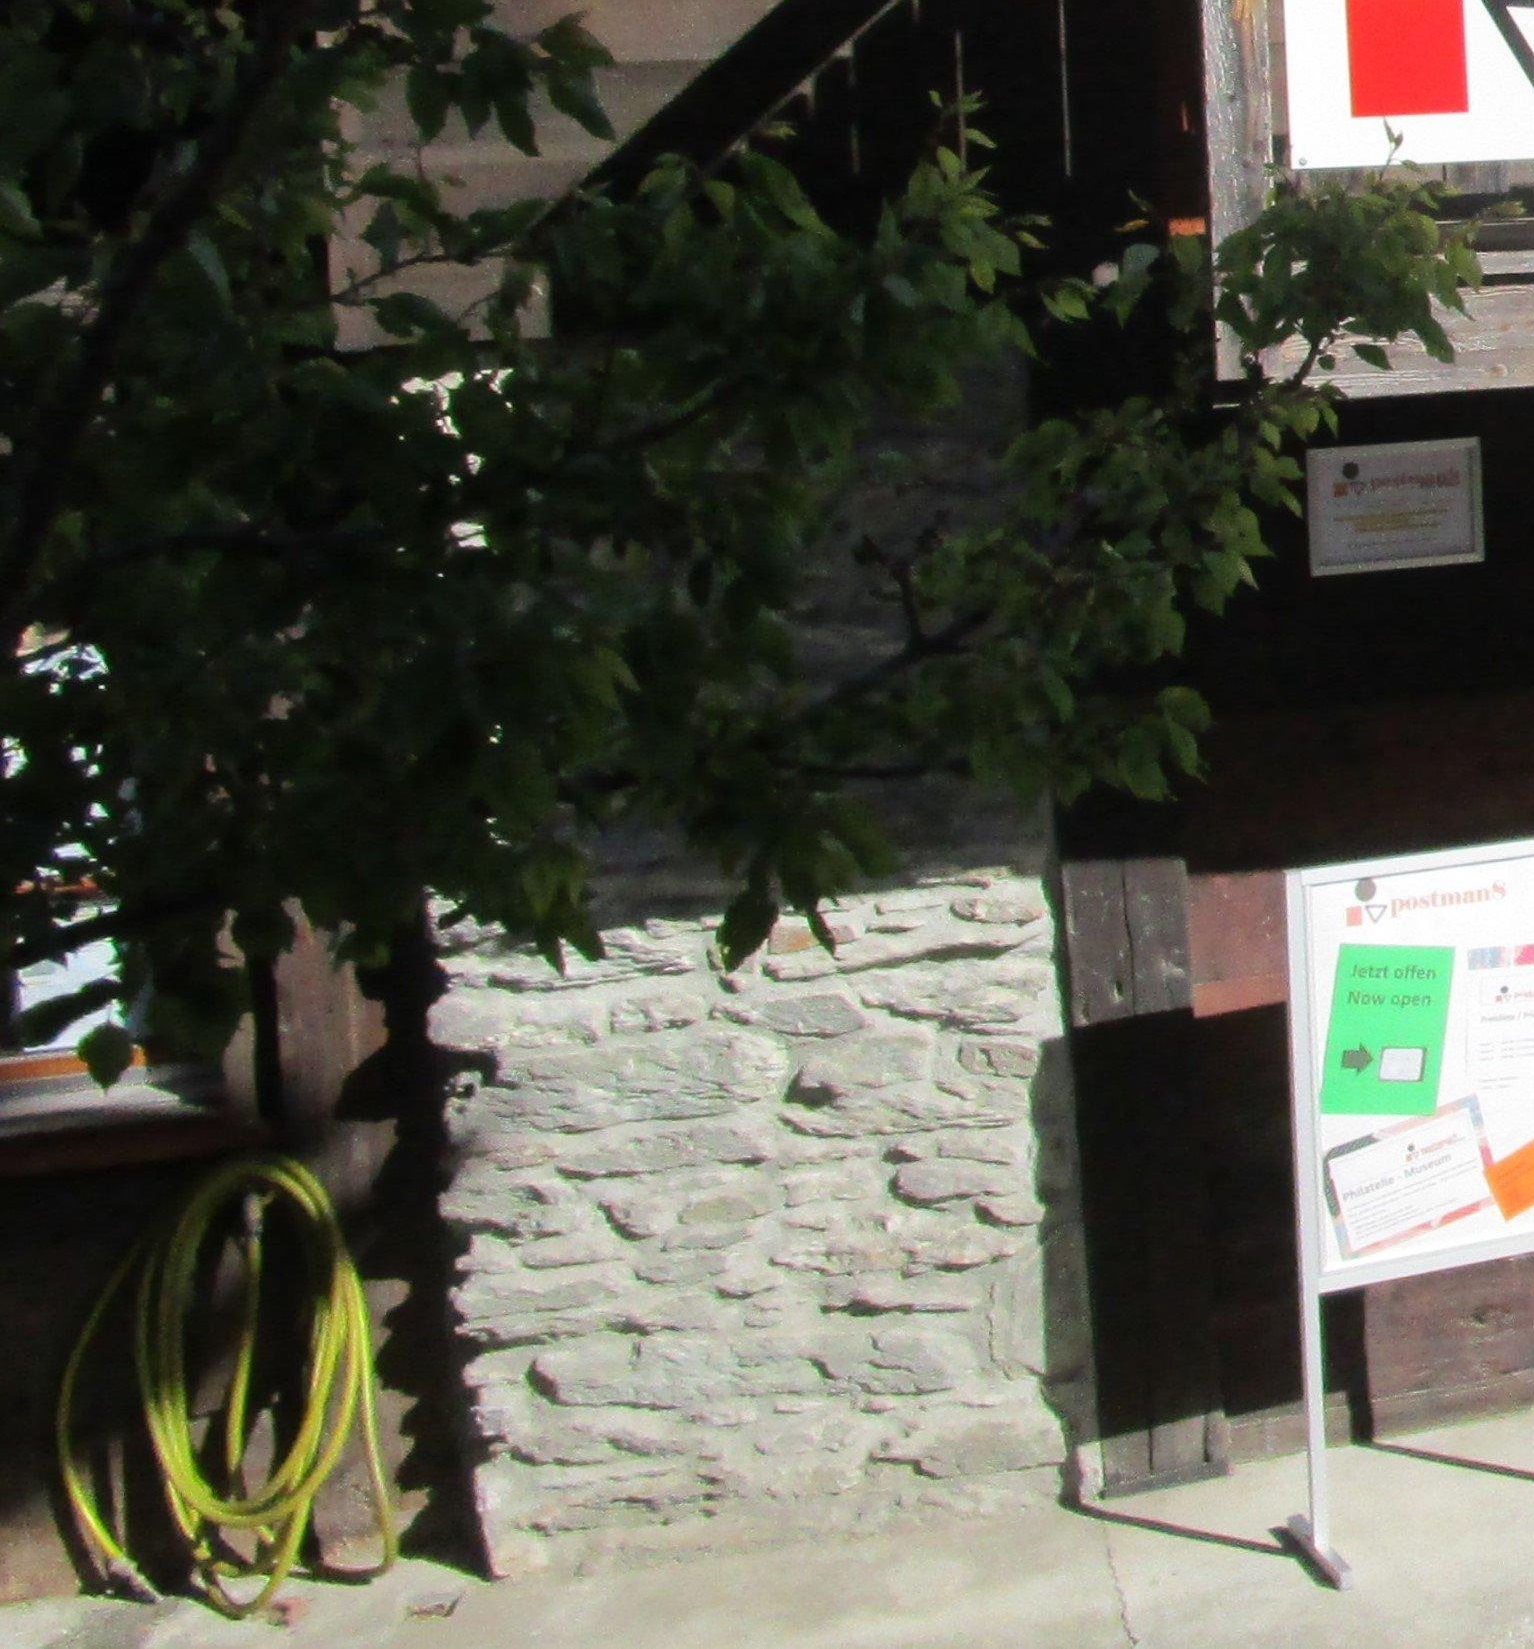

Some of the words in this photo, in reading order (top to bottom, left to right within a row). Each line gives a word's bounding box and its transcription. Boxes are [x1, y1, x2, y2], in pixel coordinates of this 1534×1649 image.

[1391, 880, 1507, 918] postman8
[1351, 964, 1389, 979] Jetzt
[1393, 964, 1437, 980] offen
[1347, 990, 1385, 1005] Now
[1390, 994, 1432, 1008] open
[1403, 1153, 1453, 1179] Museum
